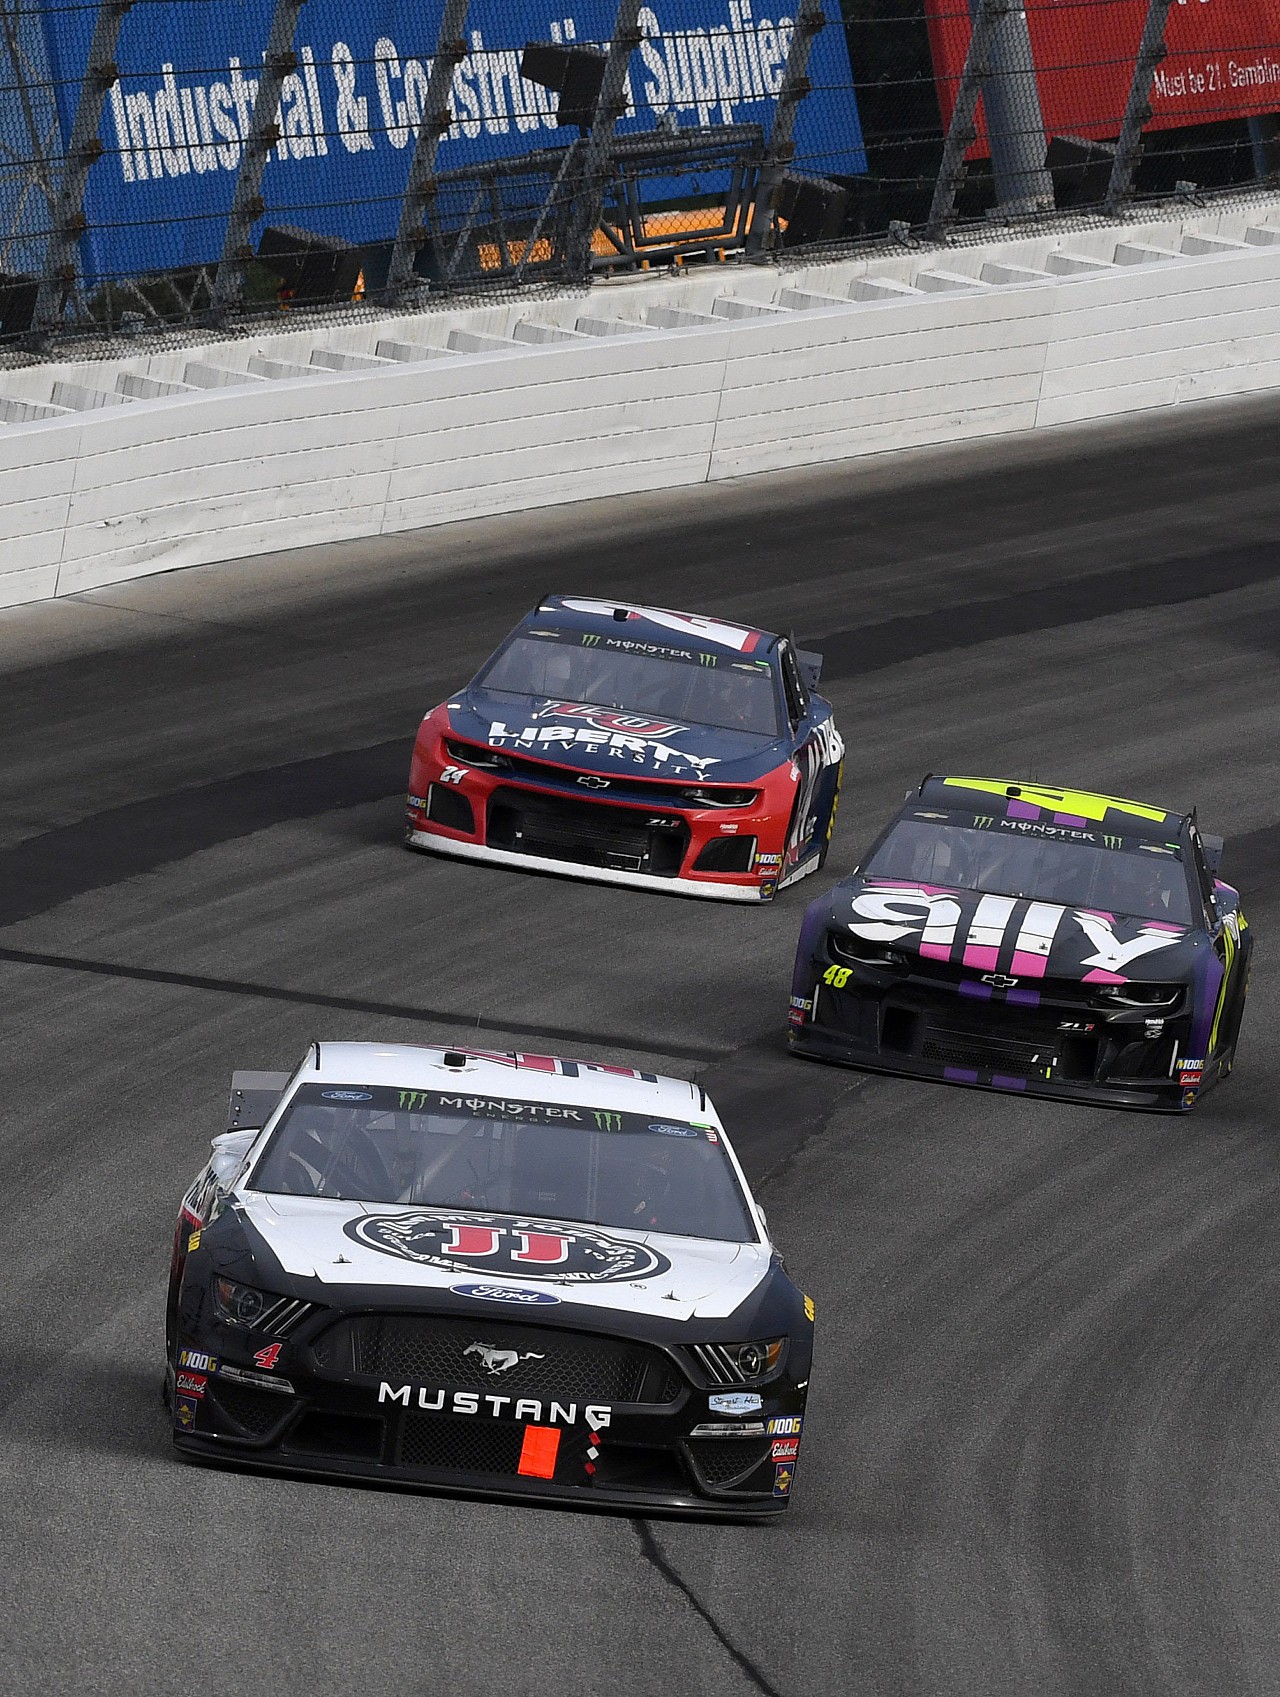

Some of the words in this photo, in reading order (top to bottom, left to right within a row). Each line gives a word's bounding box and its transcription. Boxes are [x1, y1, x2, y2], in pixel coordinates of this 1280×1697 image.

[1153, 69, 1187, 98] Must
[1188, 67, 1205, 94] be
[1206, 61, 1228, 92] 21.
[332, 41, 376, 155] &
[606, 638, 692, 660] MONSTER
[488, 721, 722, 770] LIBERTY
[487, 737, 712, 781] UNIVERSITY
[440, 765, 470, 784] 24
[1000, 820, 1096, 842] MONSTER
[848, 887, 1183, 982] ally
[823, 964, 853, 988] 48
[440, 1096, 584, 1122] MONSTER
[472, 1111, 551, 1124] ENERGY
[471, 1284, 541, 1303] Ford
[179, 1350, 218, 1372] MOOG
[253, 1342, 283, 1370] 4
[378, 1381, 613, 1430] MUSTANG
[766, 1418, 802, 1435] MOOG
